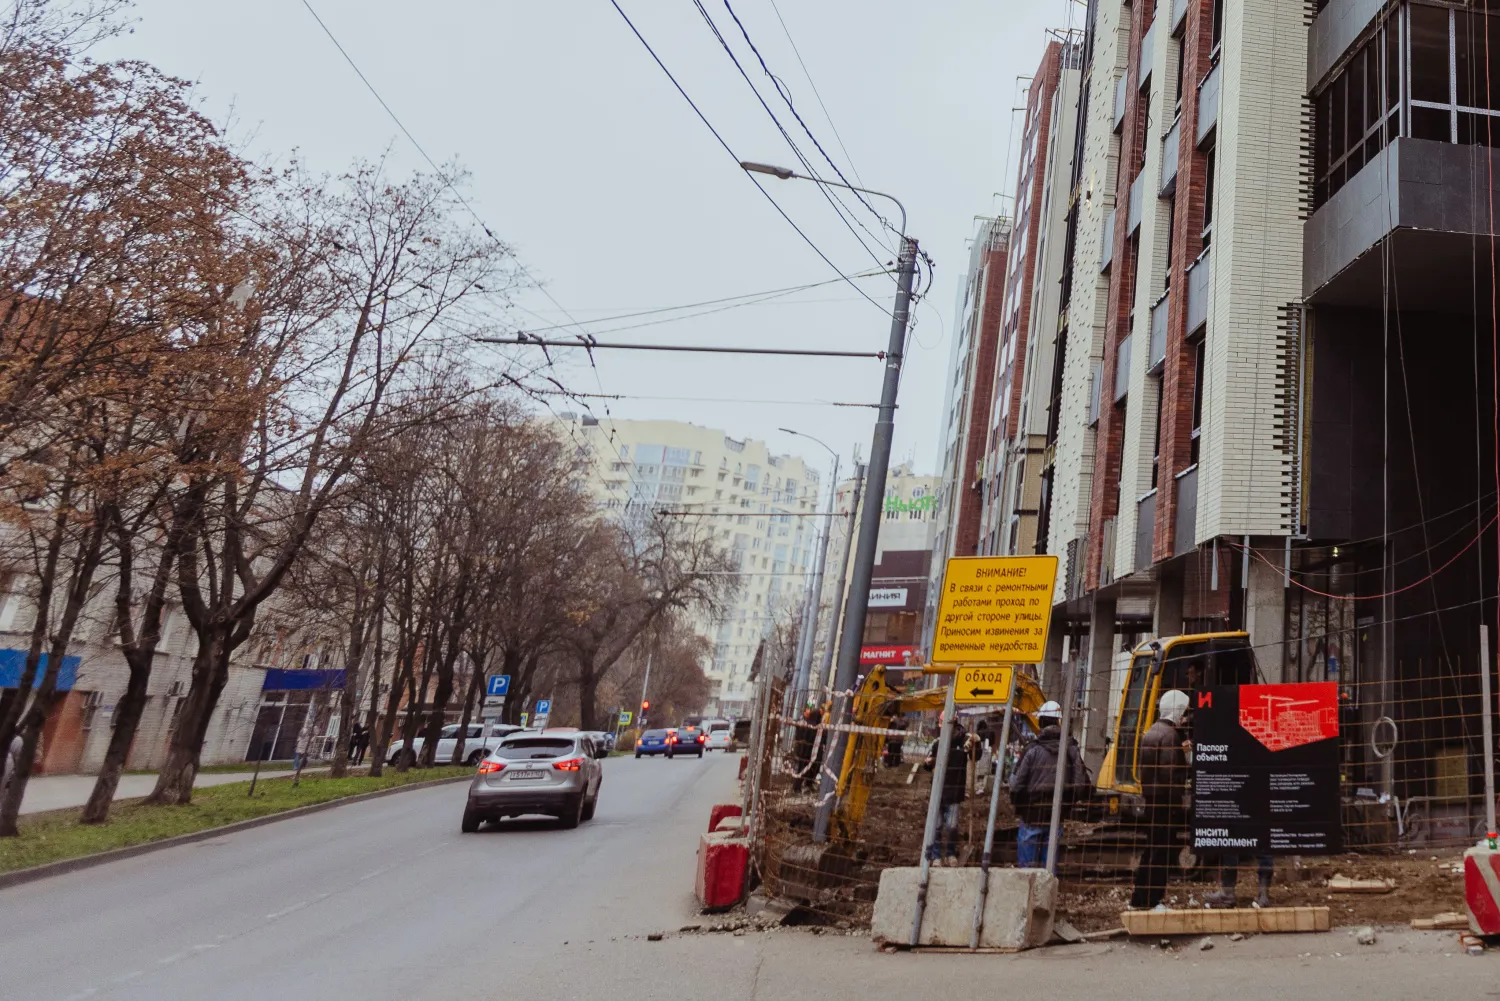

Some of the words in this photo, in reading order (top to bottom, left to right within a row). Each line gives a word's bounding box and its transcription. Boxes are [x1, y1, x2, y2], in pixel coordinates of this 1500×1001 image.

[976, 568, 1026, 578] ВНИМАНИЕ!
[950, 583, 956, 593] В
[996, 584, 1048, 593] ремонтными
[953, 597, 991, 609] работами
[996, 599, 1025, 608] проход
[945, 612, 973, 623] другой
[977, 613, 1010, 623] стороне
[1015, 613, 1042, 623] улицы.
[941, 626, 981, 638] Приносим
[940, 643, 985, 652] временные
[990, 640, 1038, 652] неудобства.
[863, 650, 896, 659] МАГНИТ
[965, 670, 1002, 683] обход
[1197, 743, 1228, 753] Паспорт
[1196, 752, 1227, 761] объекта
